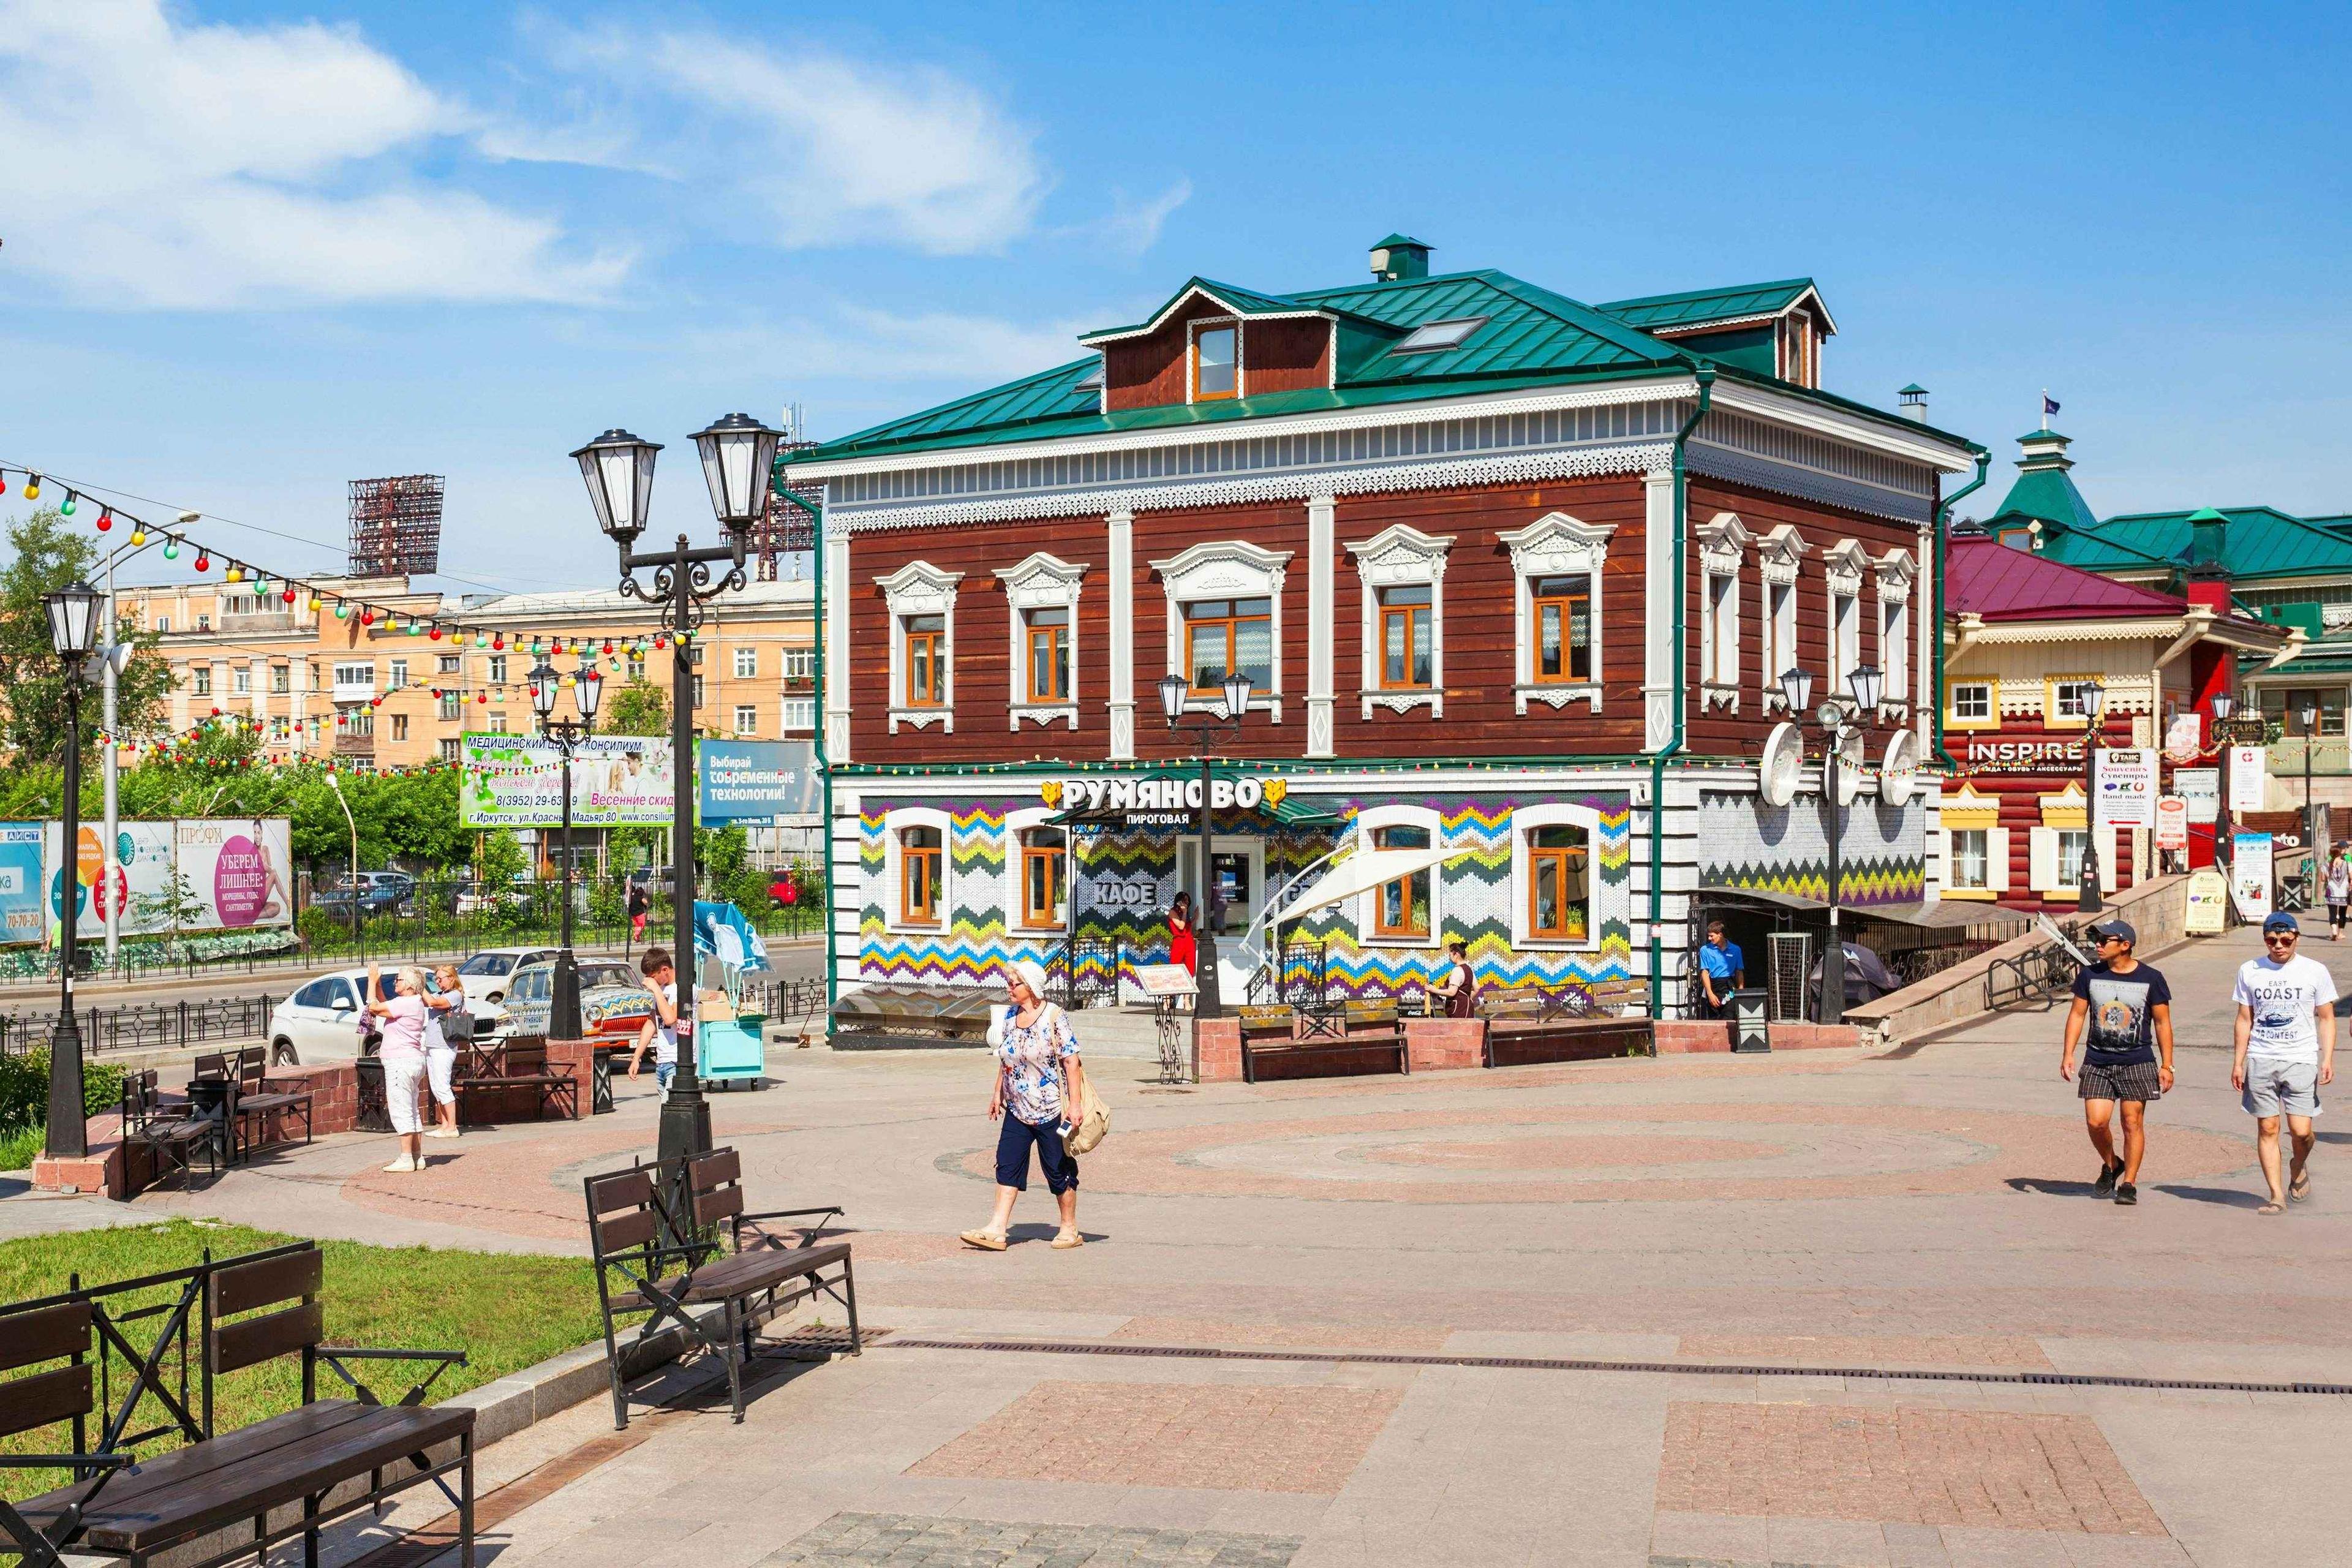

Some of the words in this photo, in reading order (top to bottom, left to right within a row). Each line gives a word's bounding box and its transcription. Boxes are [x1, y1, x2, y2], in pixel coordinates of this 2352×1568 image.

[1968, 742, 2084, 760] INSPIRE
[710, 755, 752, 769] Выбирай
[709, 769, 795, 787] современные
[591, 793, 646, 806] Весенние
[710, 785, 785, 801] технологии!
[1063, 778, 1262, 810] РУМЯНОВО
[496, 795, 533, 807] 8(3952)
[469, 812, 516, 824] г.Иркутск,
[519, 812, 564, 824] ул.Красны
[571, 812, 604, 824] Мадьяр
[606, 812, 617, 822] 80
[1126, 813, 1189, 824] ПИРОГОВАЯ
[7, 831, 39, 841] АИСТ
[221, 854, 258, 870] УБЕРЕМ
[219, 872, 263, 889] ЛИШНЕЕ:
[1093, 883, 1156, 905] КАФЕ
[8, 913, 39, 928] 70-70-20
[2254, 987, 2302, 1000] COAST
